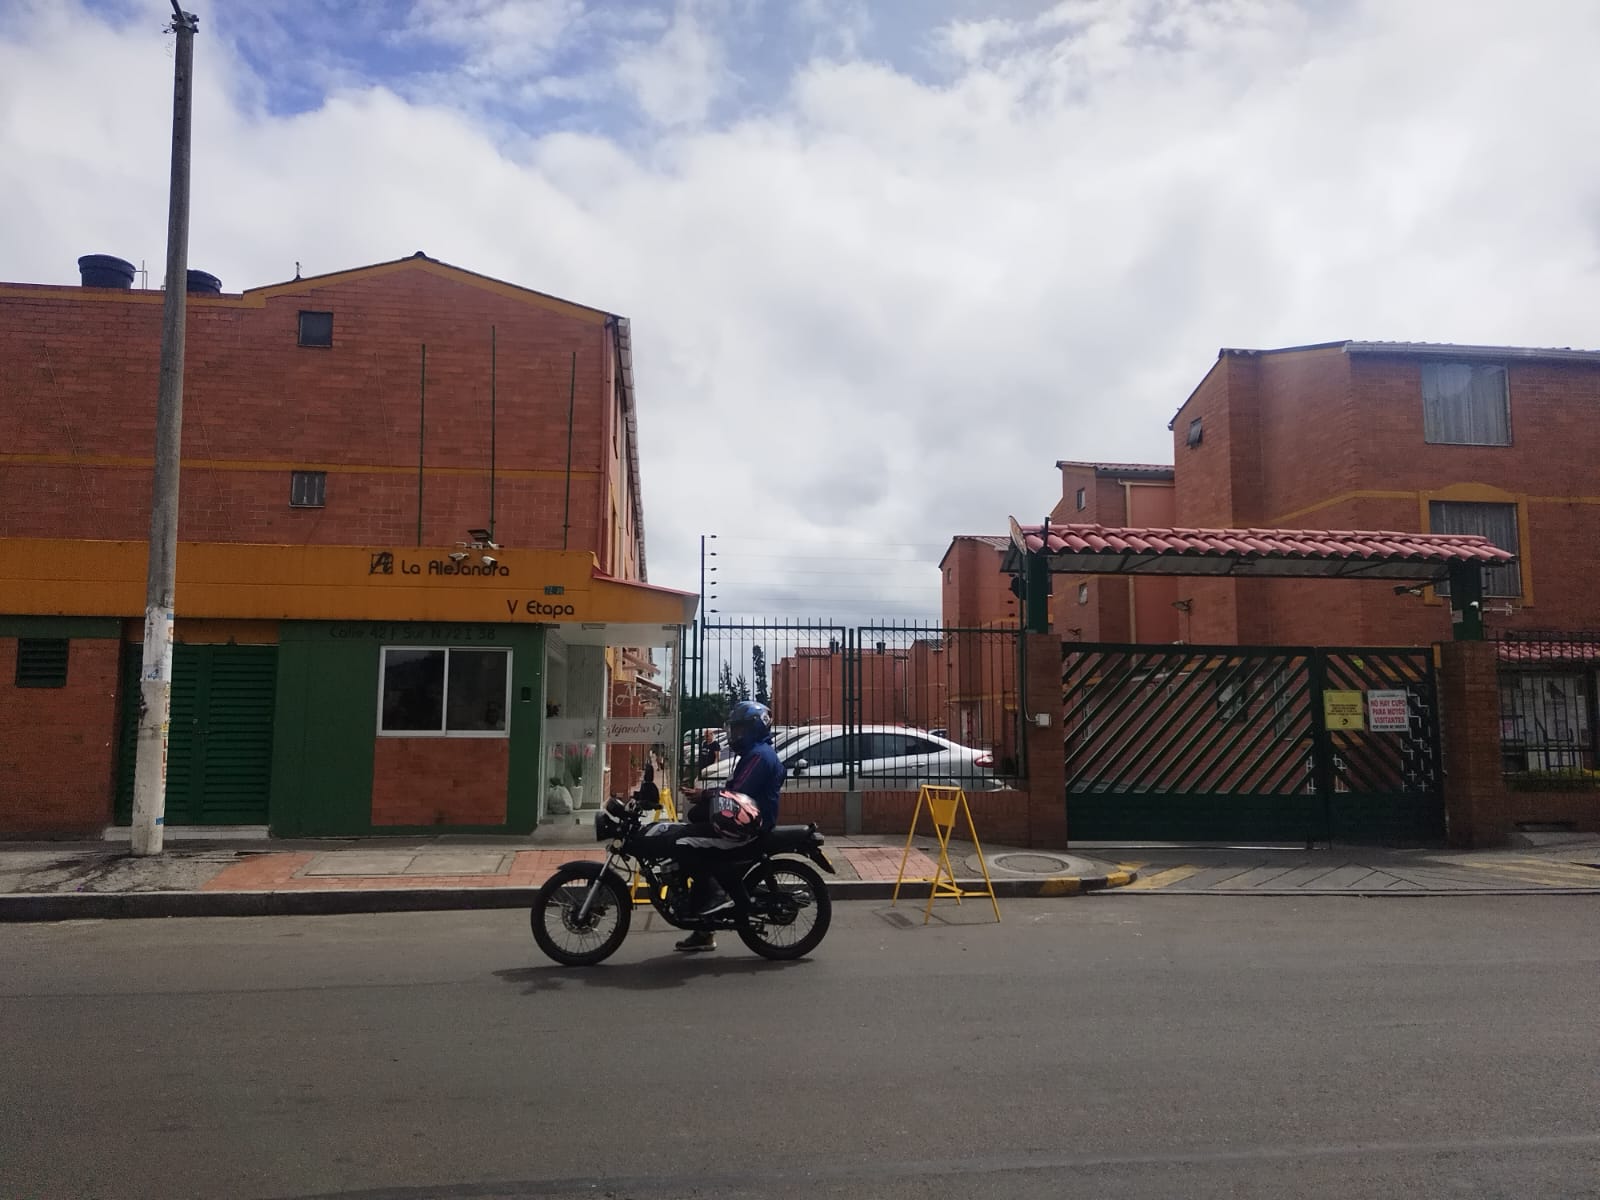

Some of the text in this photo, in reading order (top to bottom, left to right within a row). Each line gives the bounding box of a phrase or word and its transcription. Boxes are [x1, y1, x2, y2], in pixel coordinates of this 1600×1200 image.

[402, 560, 420, 575] La
[506, 599, 575, 619] V Etapa
[329, 625, 364, 640] Calle
[402, 625, 426, 640] Sur
[1391, 699, 1405, 707] CUPO
